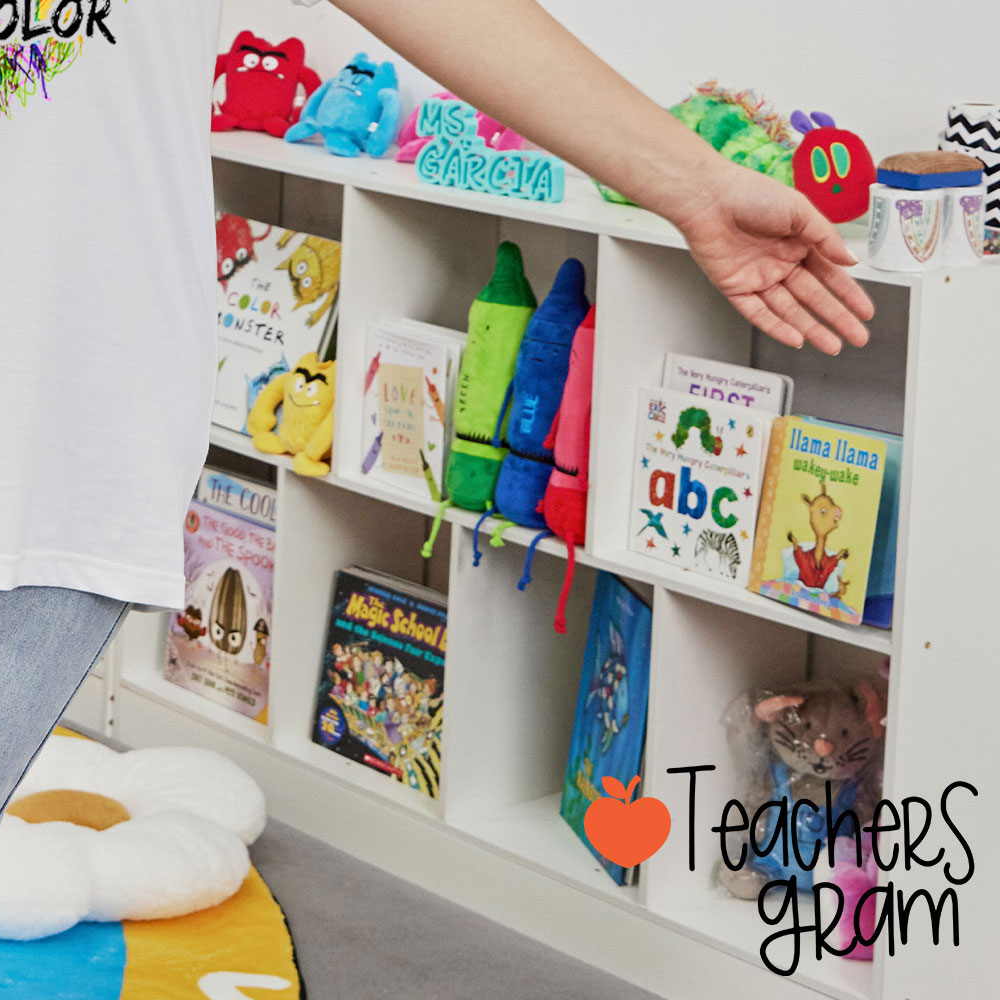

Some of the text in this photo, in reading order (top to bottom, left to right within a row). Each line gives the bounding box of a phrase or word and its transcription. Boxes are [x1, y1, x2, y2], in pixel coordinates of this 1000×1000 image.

[420, 102, 466, 136] MS
[418, 144, 553, 200] GARCIA
[251, 277, 272, 292] THE
[227, 291, 282, 320] COLOR
[678, 366, 689, 376] The
[690, 369, 704, 382] Very
[706, 373, 729, 387] Hungry
[646, 442, 658, 454] The
[677, 453, 702, 469] Hungry
[789, 427, 879, 471] llama llama
[793, 457, 860, 486] wakey-wake
[211, 477, 277, 522] THE COOL
[649, 465, 739, 529] abc
[367, 595, 386, 610] The
[346, 592, 391, 628] Magic
[390, 607, 442, 647] School
